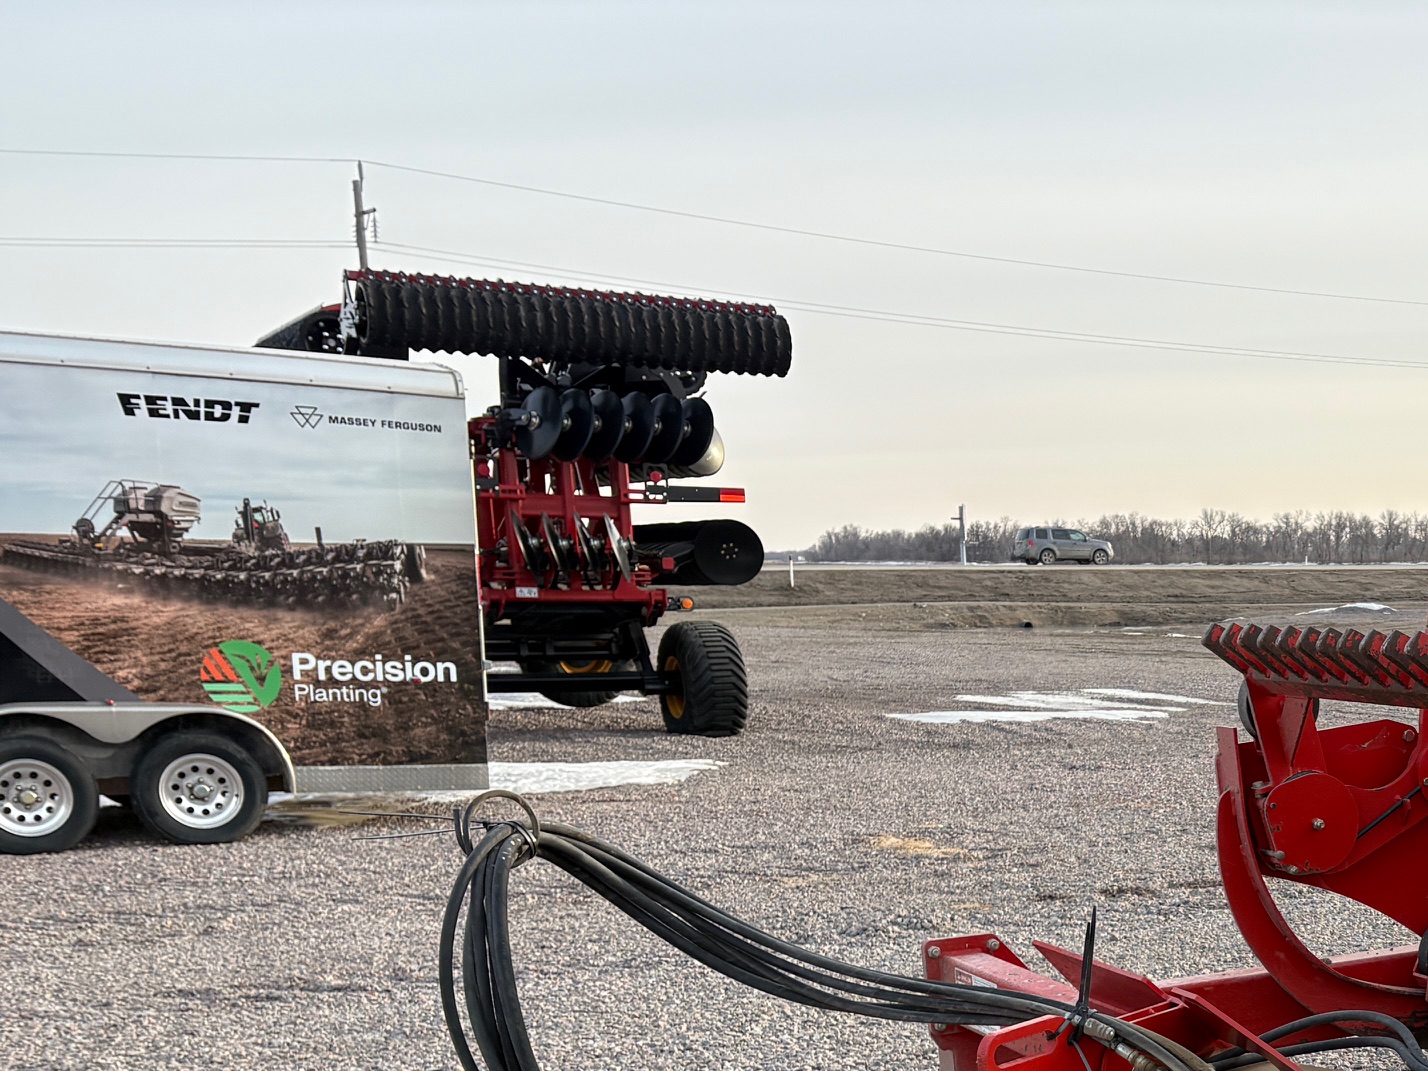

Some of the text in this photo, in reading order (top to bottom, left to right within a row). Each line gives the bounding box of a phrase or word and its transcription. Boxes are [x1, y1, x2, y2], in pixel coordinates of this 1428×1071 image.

[116, 392, 261, 424] FENDT
[328, 415, 442, 433] MASSEY FERGUSON
[291, 652, 458, 683] Precision
